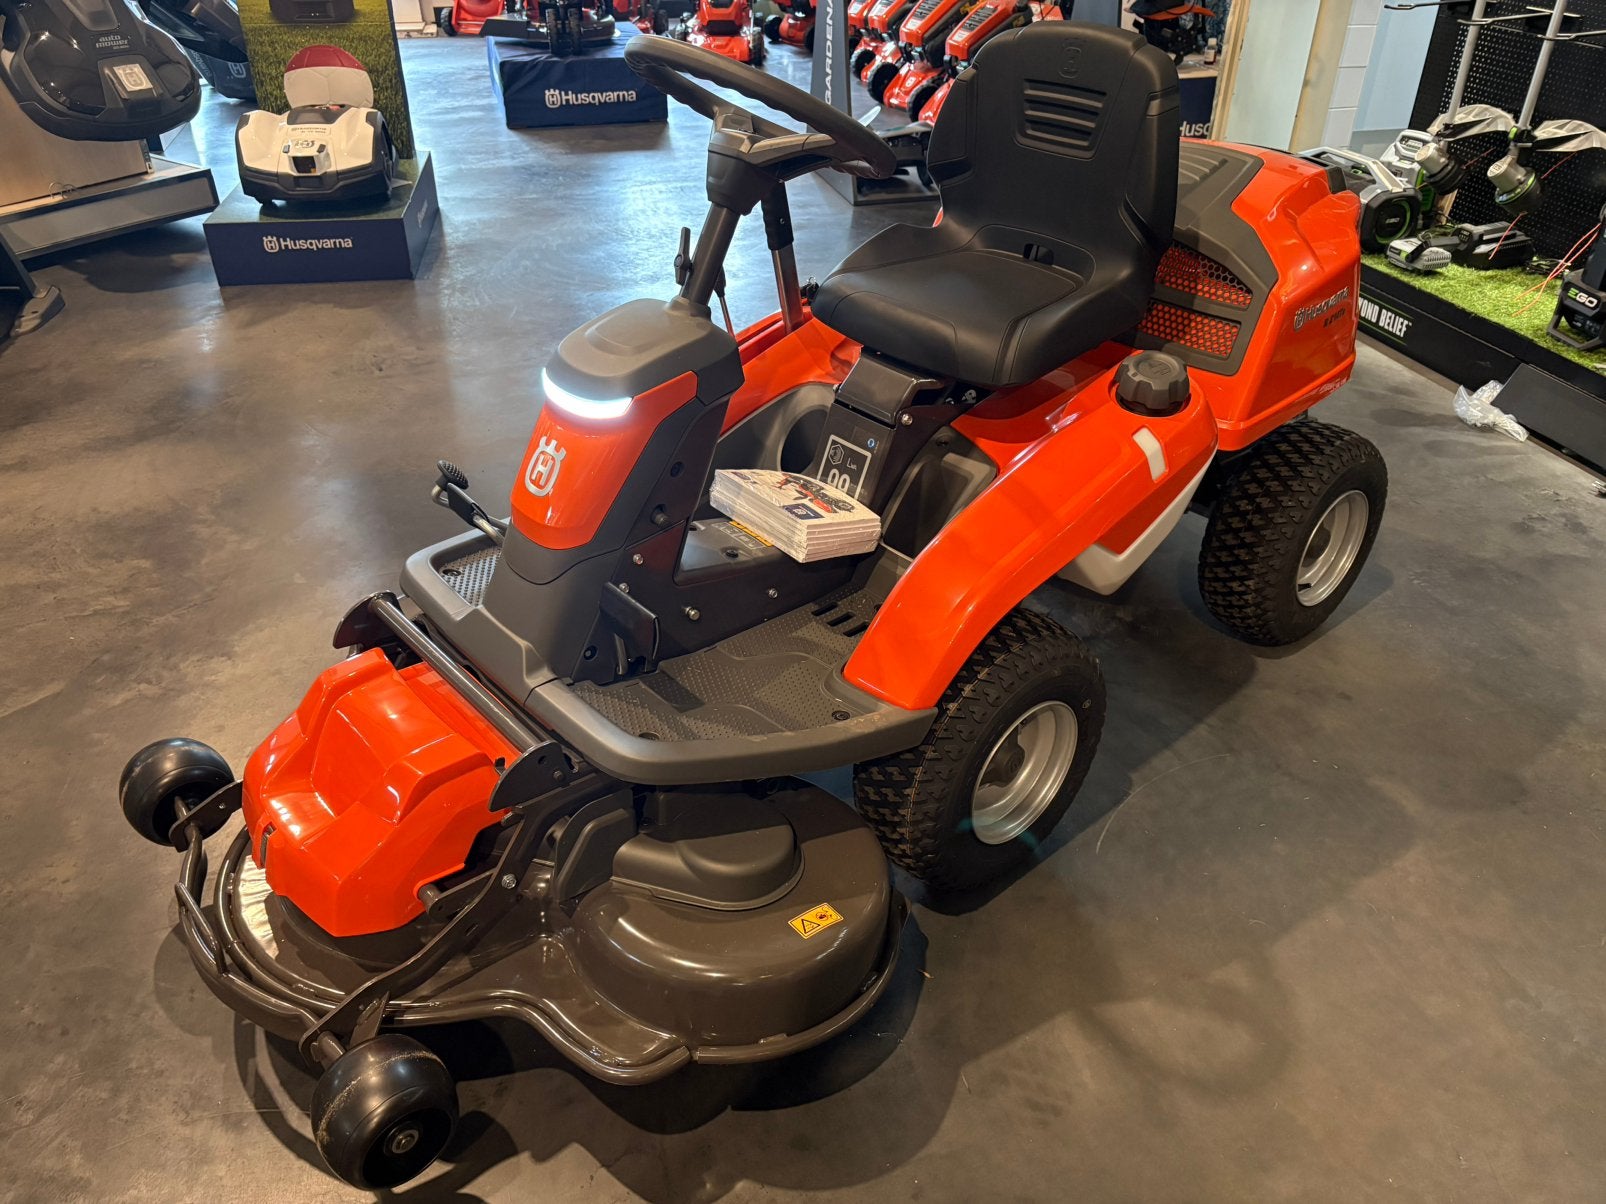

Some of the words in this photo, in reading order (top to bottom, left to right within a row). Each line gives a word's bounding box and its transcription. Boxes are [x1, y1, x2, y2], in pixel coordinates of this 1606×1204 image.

[561, 90, 637, 106] Husqvarna
[280, 237, 353, 251] Husqvarna
[1567, 287, 1598, 308] EGO
